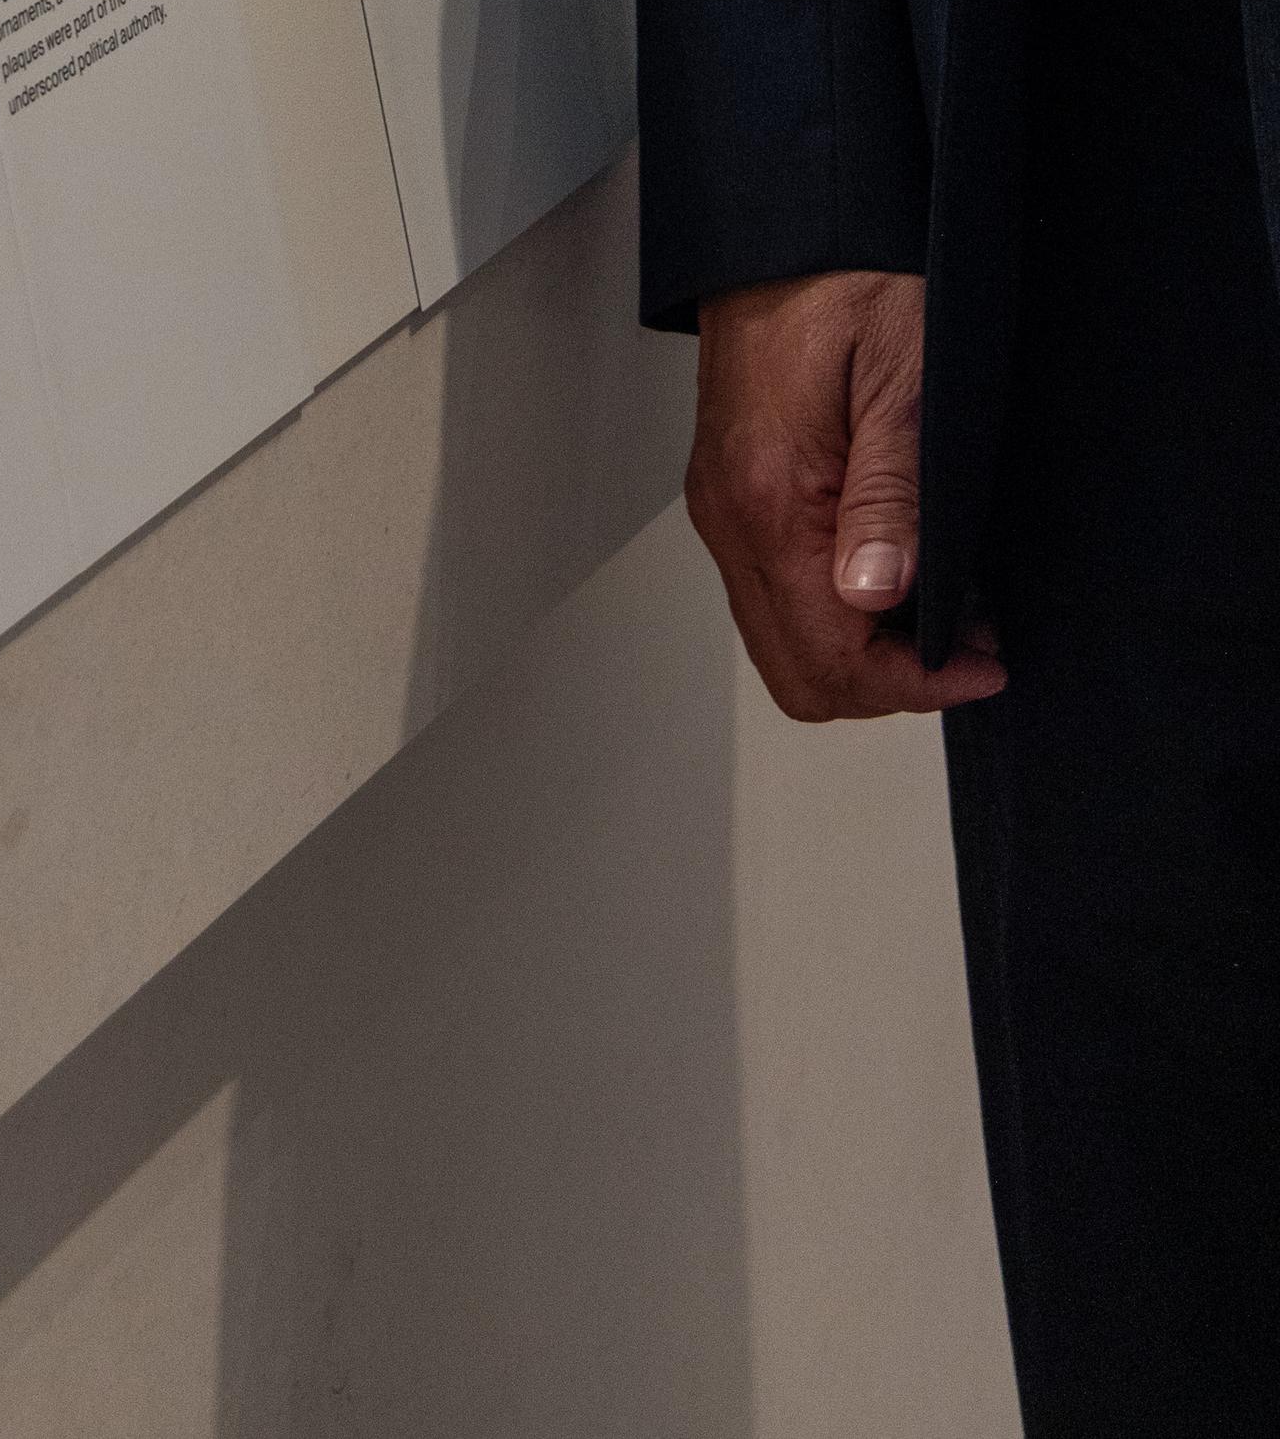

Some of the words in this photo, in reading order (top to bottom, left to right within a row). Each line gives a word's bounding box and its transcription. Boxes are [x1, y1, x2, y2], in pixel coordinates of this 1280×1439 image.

[1, 39, 45, 83] plaques
[44, 22, 72, 50] were
[72, 5, 96, 38] part
[7, 55, 77, 116] underscored
[76, 28, 119, 76] political
[119, 3, 167, 45] authority.
